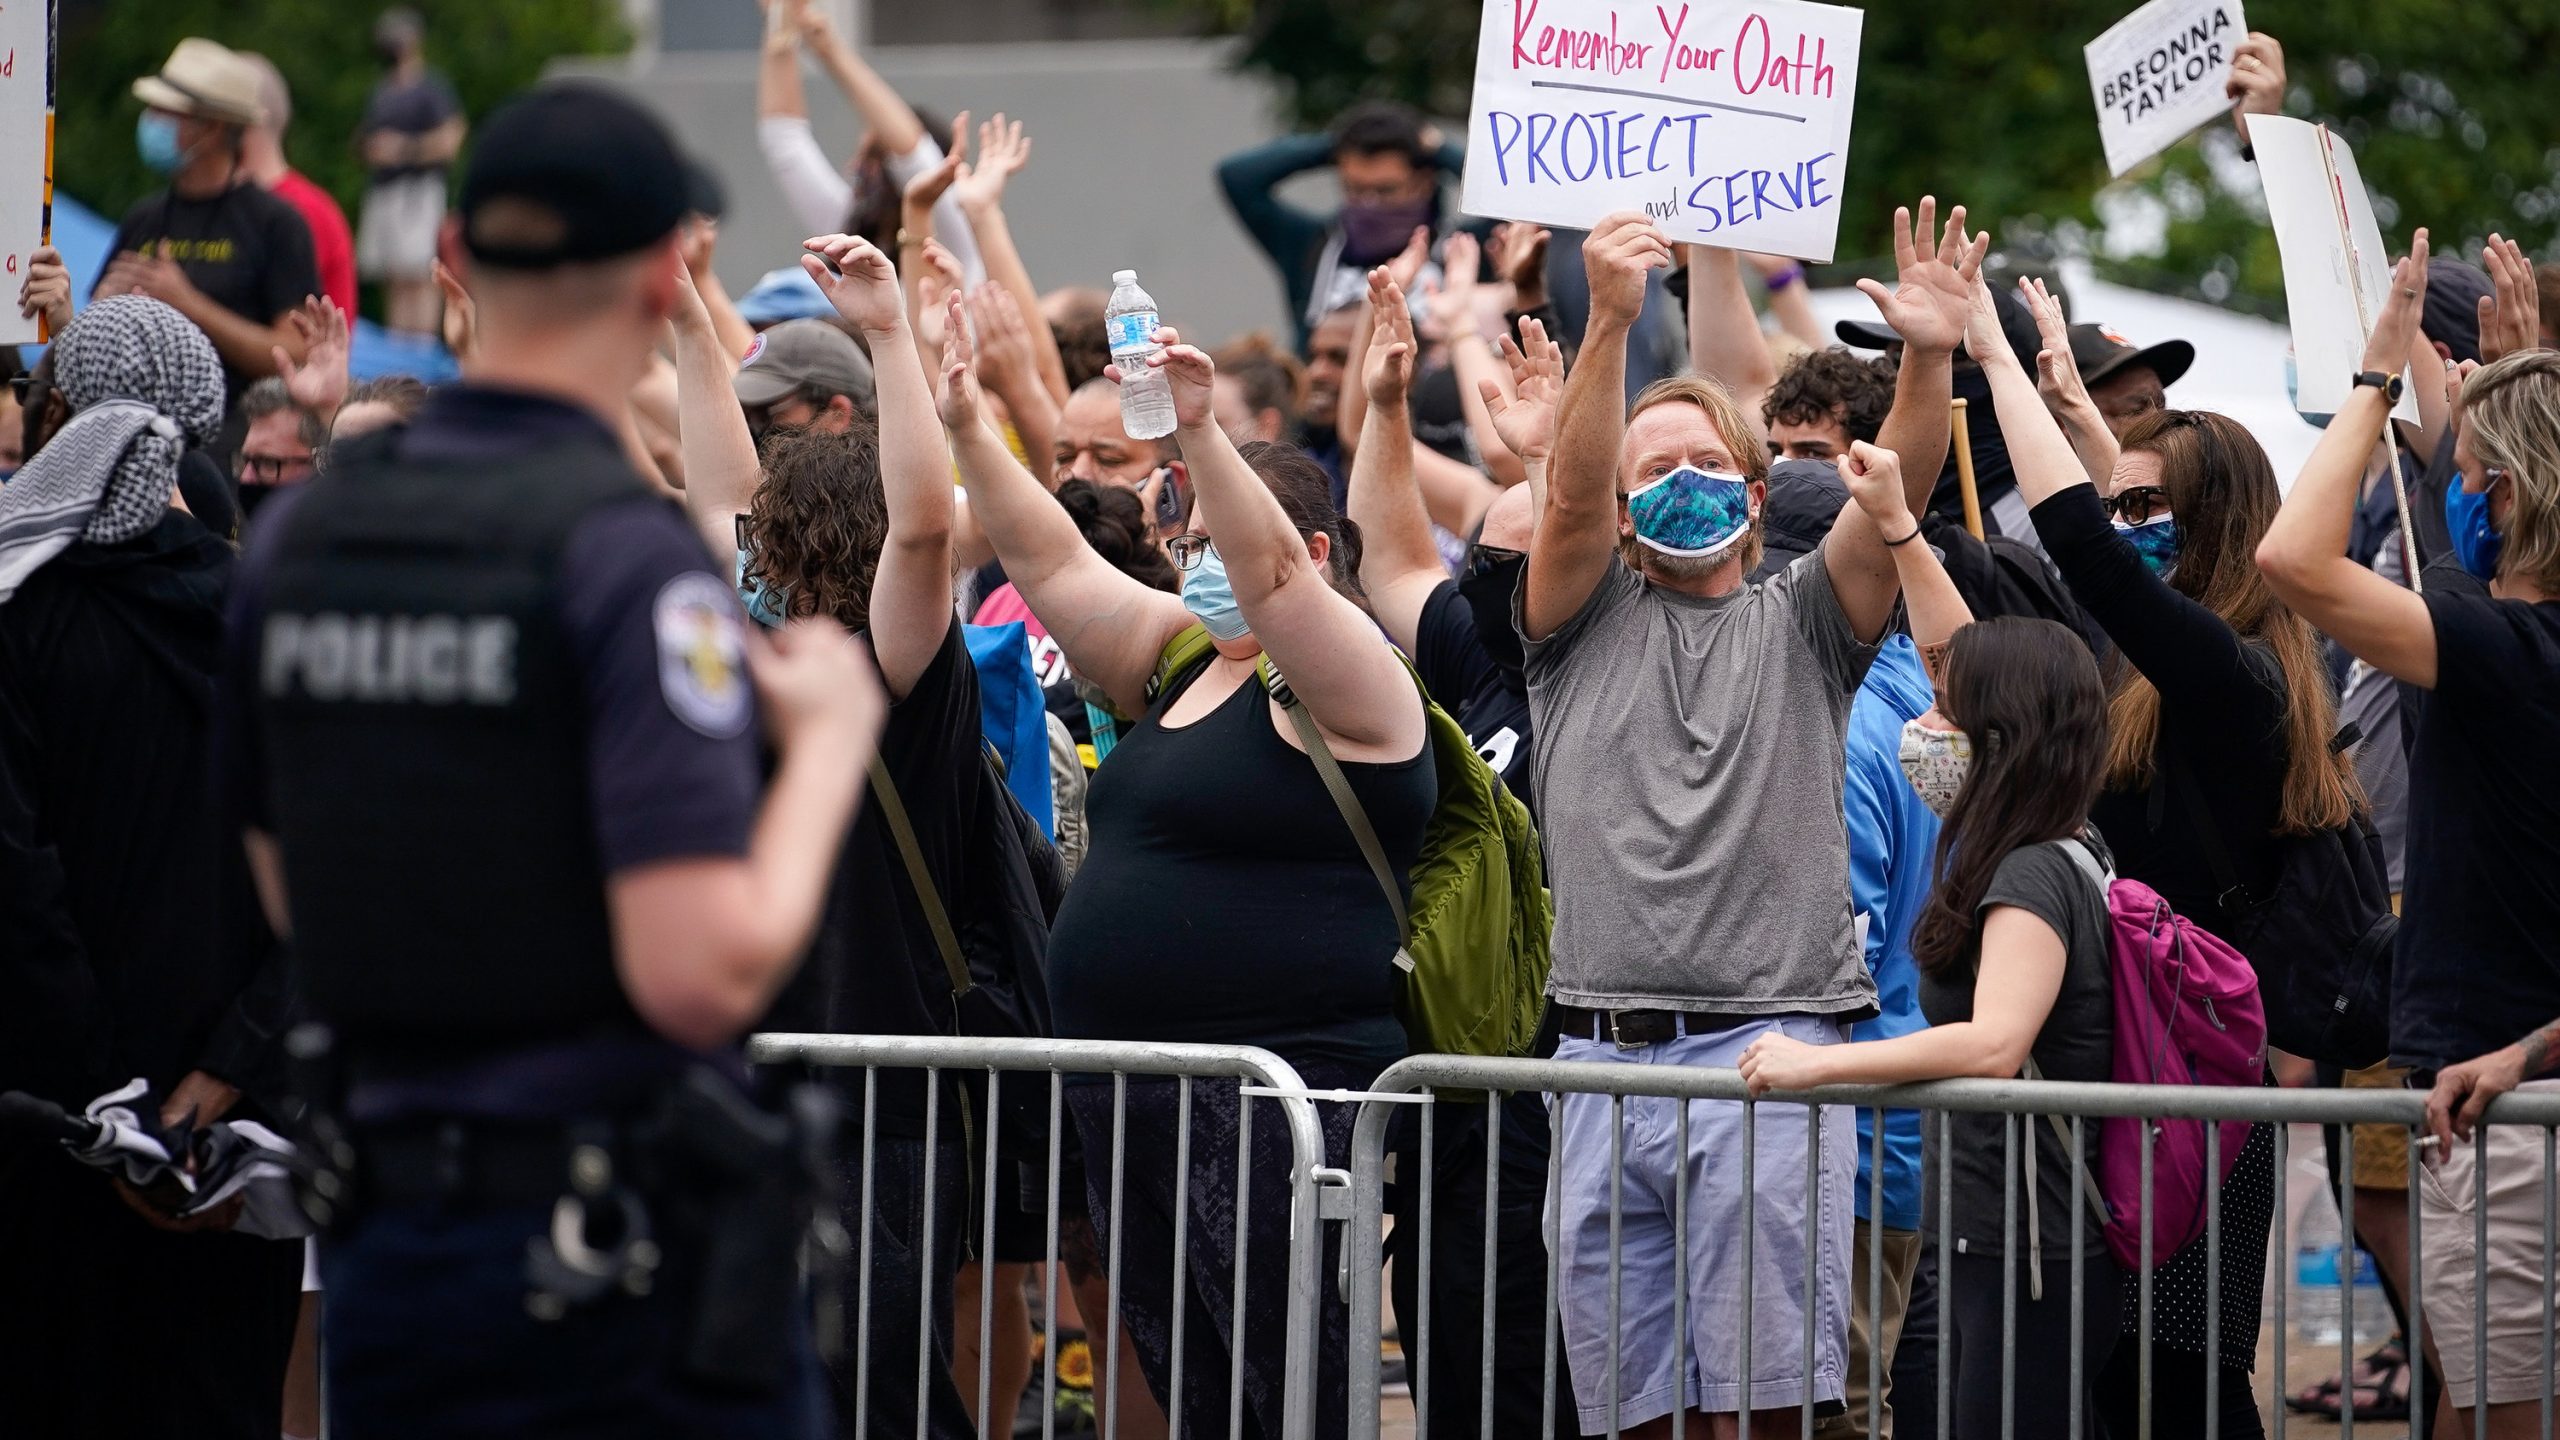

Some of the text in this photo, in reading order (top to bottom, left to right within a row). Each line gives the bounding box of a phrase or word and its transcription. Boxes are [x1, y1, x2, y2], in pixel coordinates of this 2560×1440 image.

[1513, 0, 1834, 98] Remember Your Oath
[2102, 7, 2230, 109] BREONNA
[2121, 42, 2223, 125] TAYLOR
[1488, 110, 1713, 186] PROTECT
[1645, 152, 1836, 232] and SERVE
[263, 613, 517, 703] POLICE
